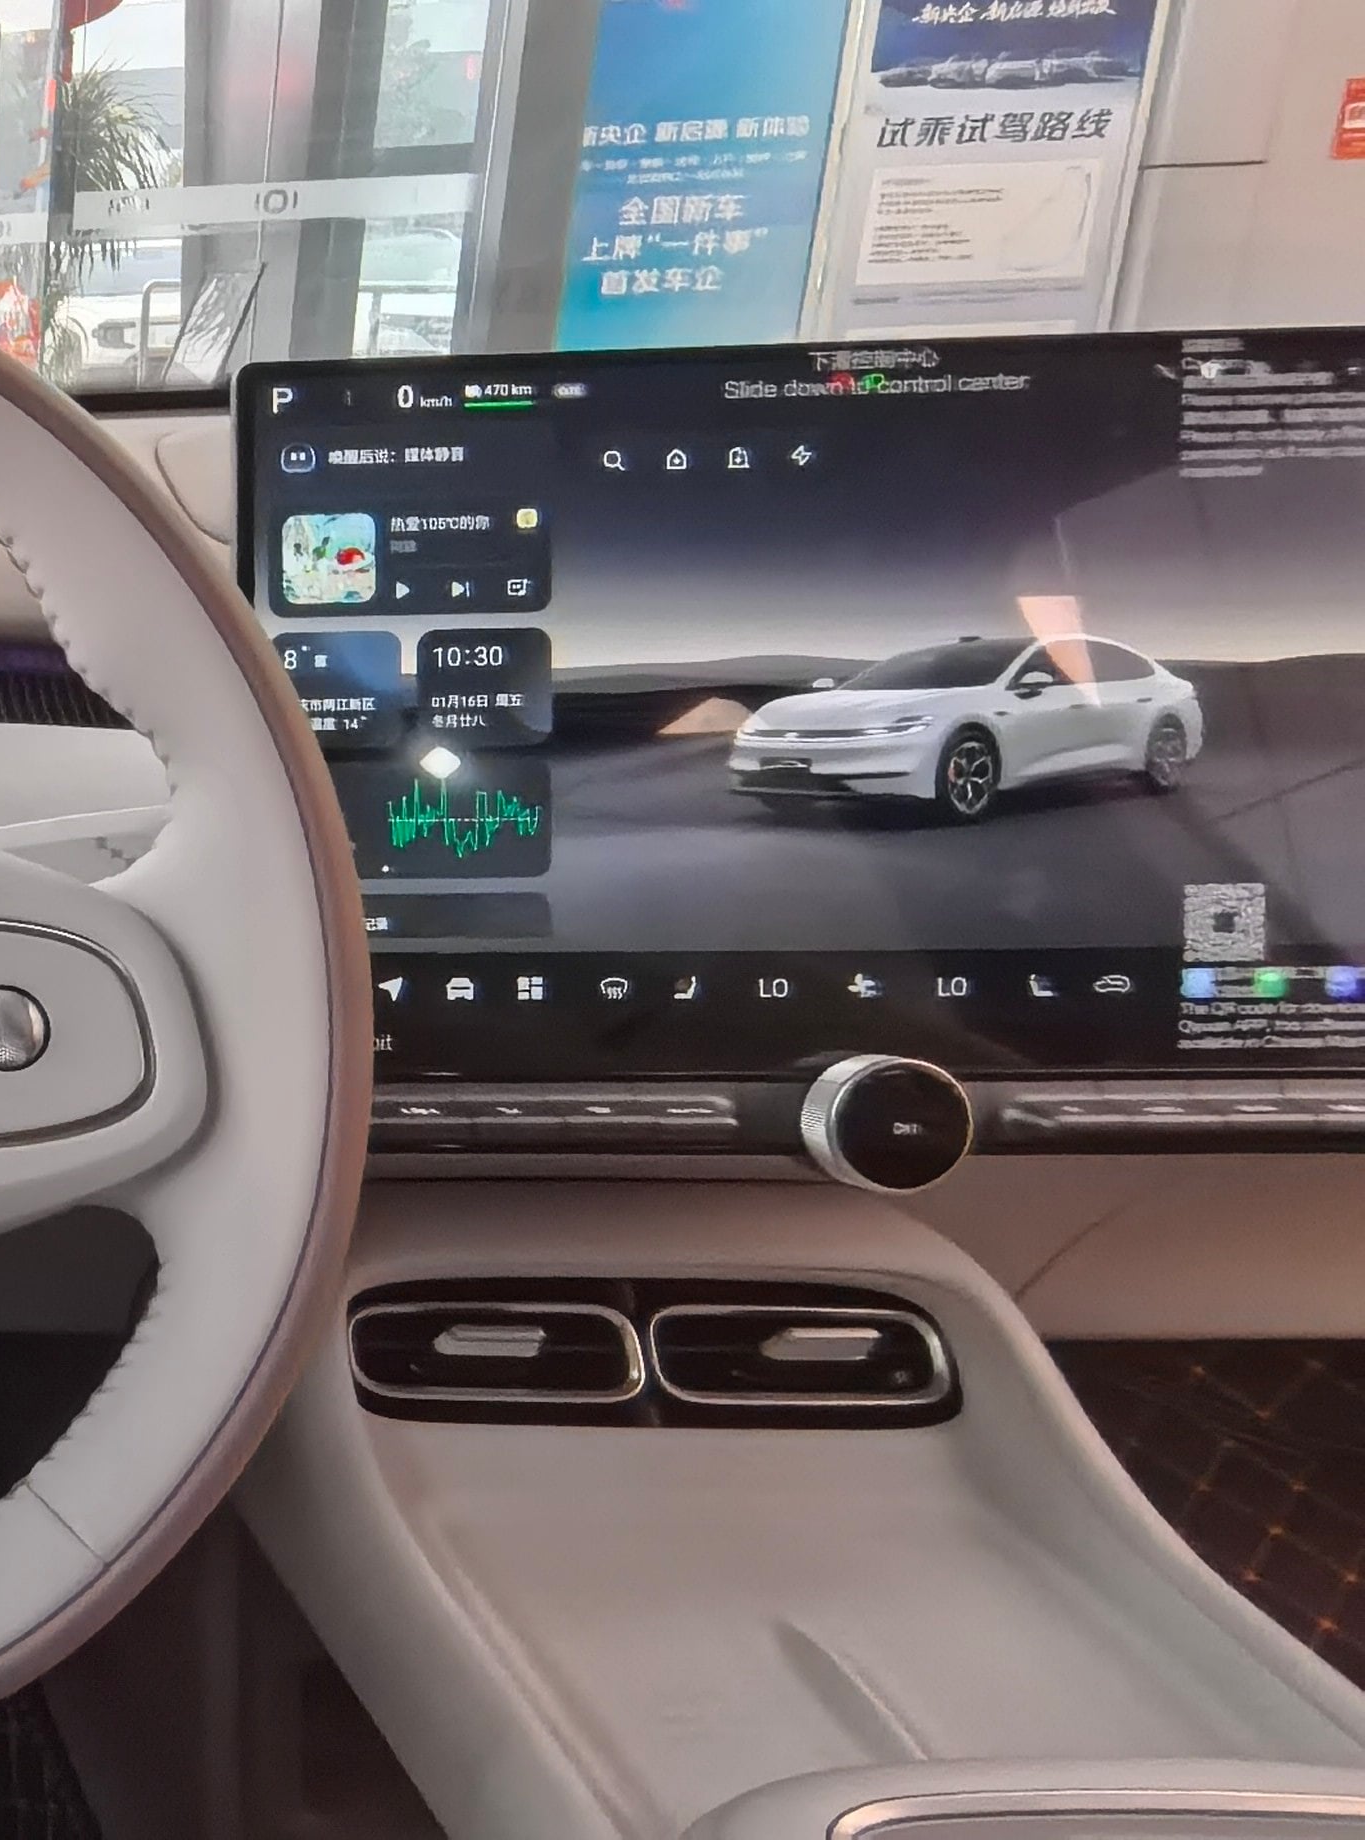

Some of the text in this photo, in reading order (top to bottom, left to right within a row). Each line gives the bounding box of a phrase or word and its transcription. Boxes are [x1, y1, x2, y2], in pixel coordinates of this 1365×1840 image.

[877, 108, 1114, 149] 试乘试驾路线
[618, 194, 750, 226] 全国新车
[600, 265, 725, 295] 首发车企
[397, 385, 453, 408] 0 km/h
[485, 384, 533, 397] 470 km
[724, 380, 777, 399] Slide
[272, 387, 294, 414] P
[432, 646, 503, 668] 10:30
[431, 693, 524, 709] 01月16日 周五
[431, 713, 486, 728] 冬月廿八
[758, 978, 789, 999] LO
[937, 976, 968, 997] LO
